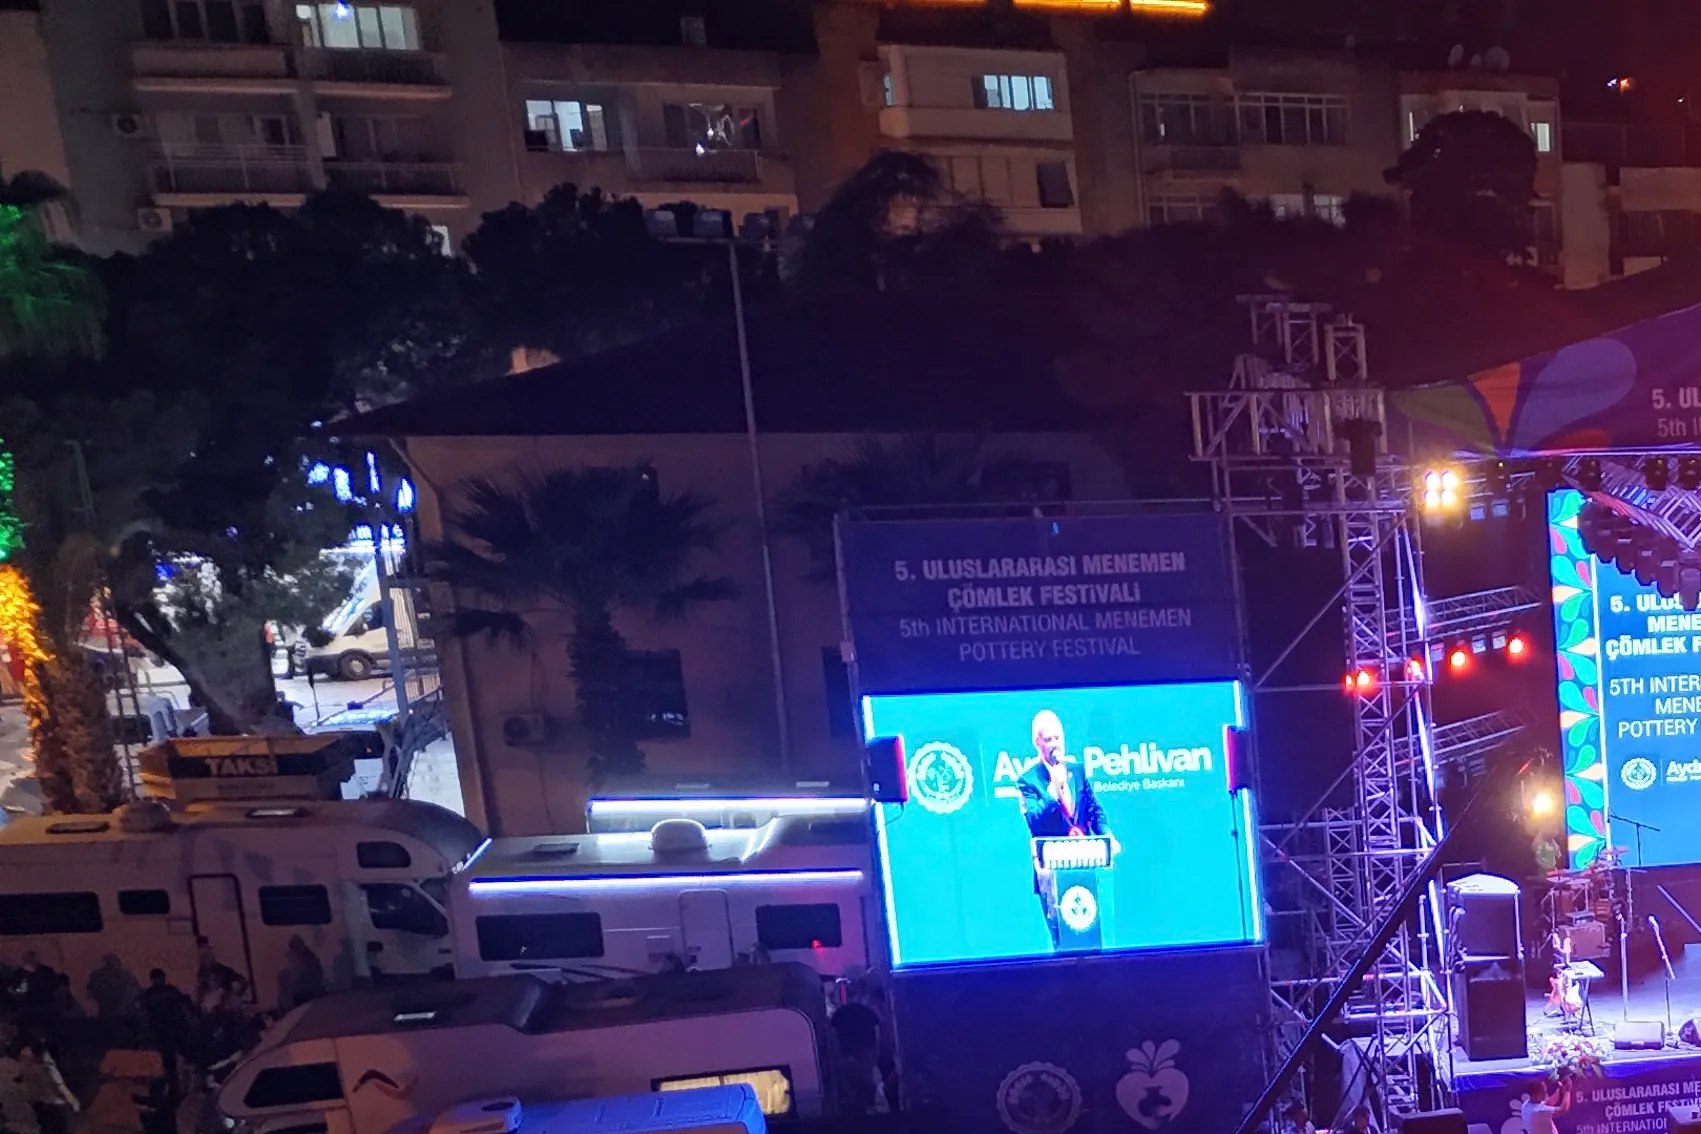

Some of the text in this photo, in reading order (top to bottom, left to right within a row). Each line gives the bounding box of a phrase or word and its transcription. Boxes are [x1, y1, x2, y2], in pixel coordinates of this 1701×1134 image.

[1651, 388, 1671, 409] 5.
[1657, 417, 1687, 438] 5th
[894, 551, 1187, 581] 5. ULUSLARARASI MENEMEN
[947, 583, 1035, 613] ÇÖMLEK
[1610, 595, 1631, 613] 5.
[899, 607, 1192, 638] 5th INTERNATIONAL MENEMEN
[959, 636, 1141, 662] POTTERY FESTIVAL
[1605, 633, 1688, 661] ÇÖMLEK
[1609, 677, 1644, 696] 5TH
[1618, 717, 1699, 738] POTTERY
[1083, 741, 1213, 778] Pehlivan
[1575, 1091, 1589, 1104] 5.
[1591, 1082, 1680, 1102] ULUSLARARASI
[1604, 1102, 1656, 1121] ÇÖMLEK
